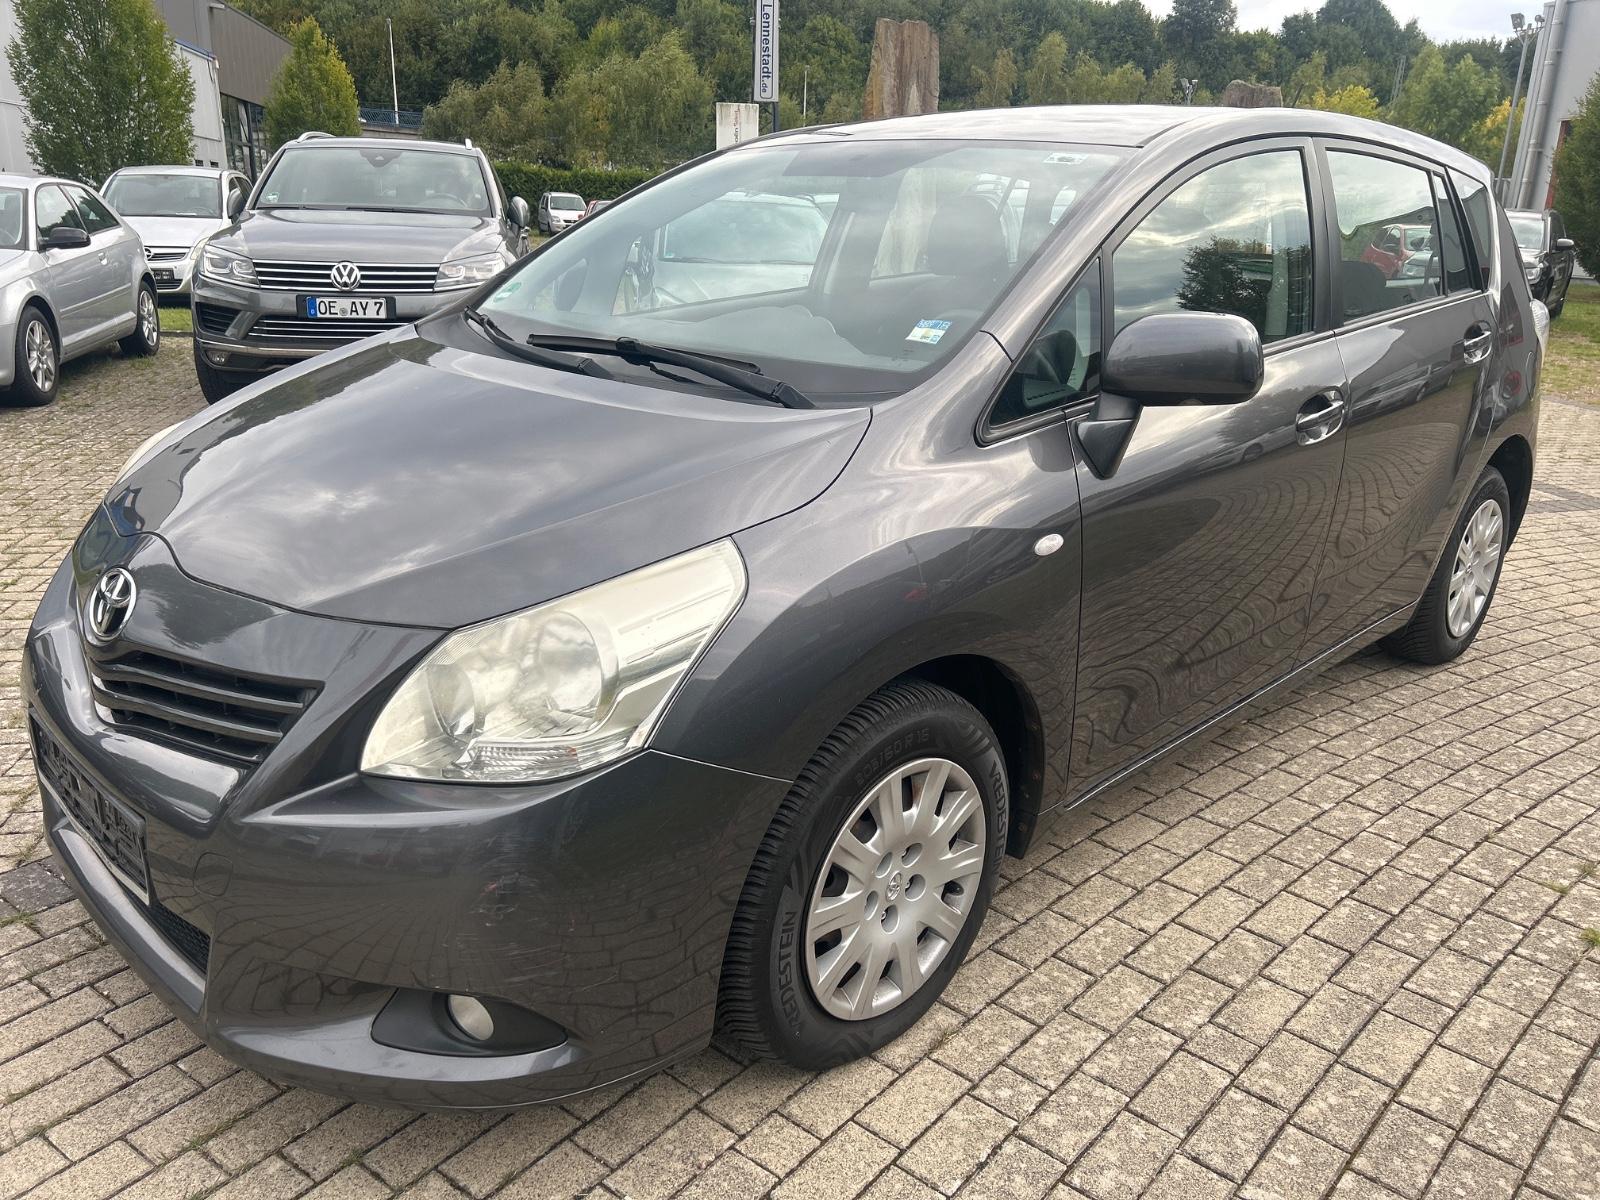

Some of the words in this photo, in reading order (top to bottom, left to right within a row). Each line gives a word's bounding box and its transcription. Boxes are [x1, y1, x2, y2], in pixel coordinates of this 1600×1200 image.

[318, 301, 338, 315] OE
[350, 301, 369, 315] AY
[374, 302, 383, 315] 7
